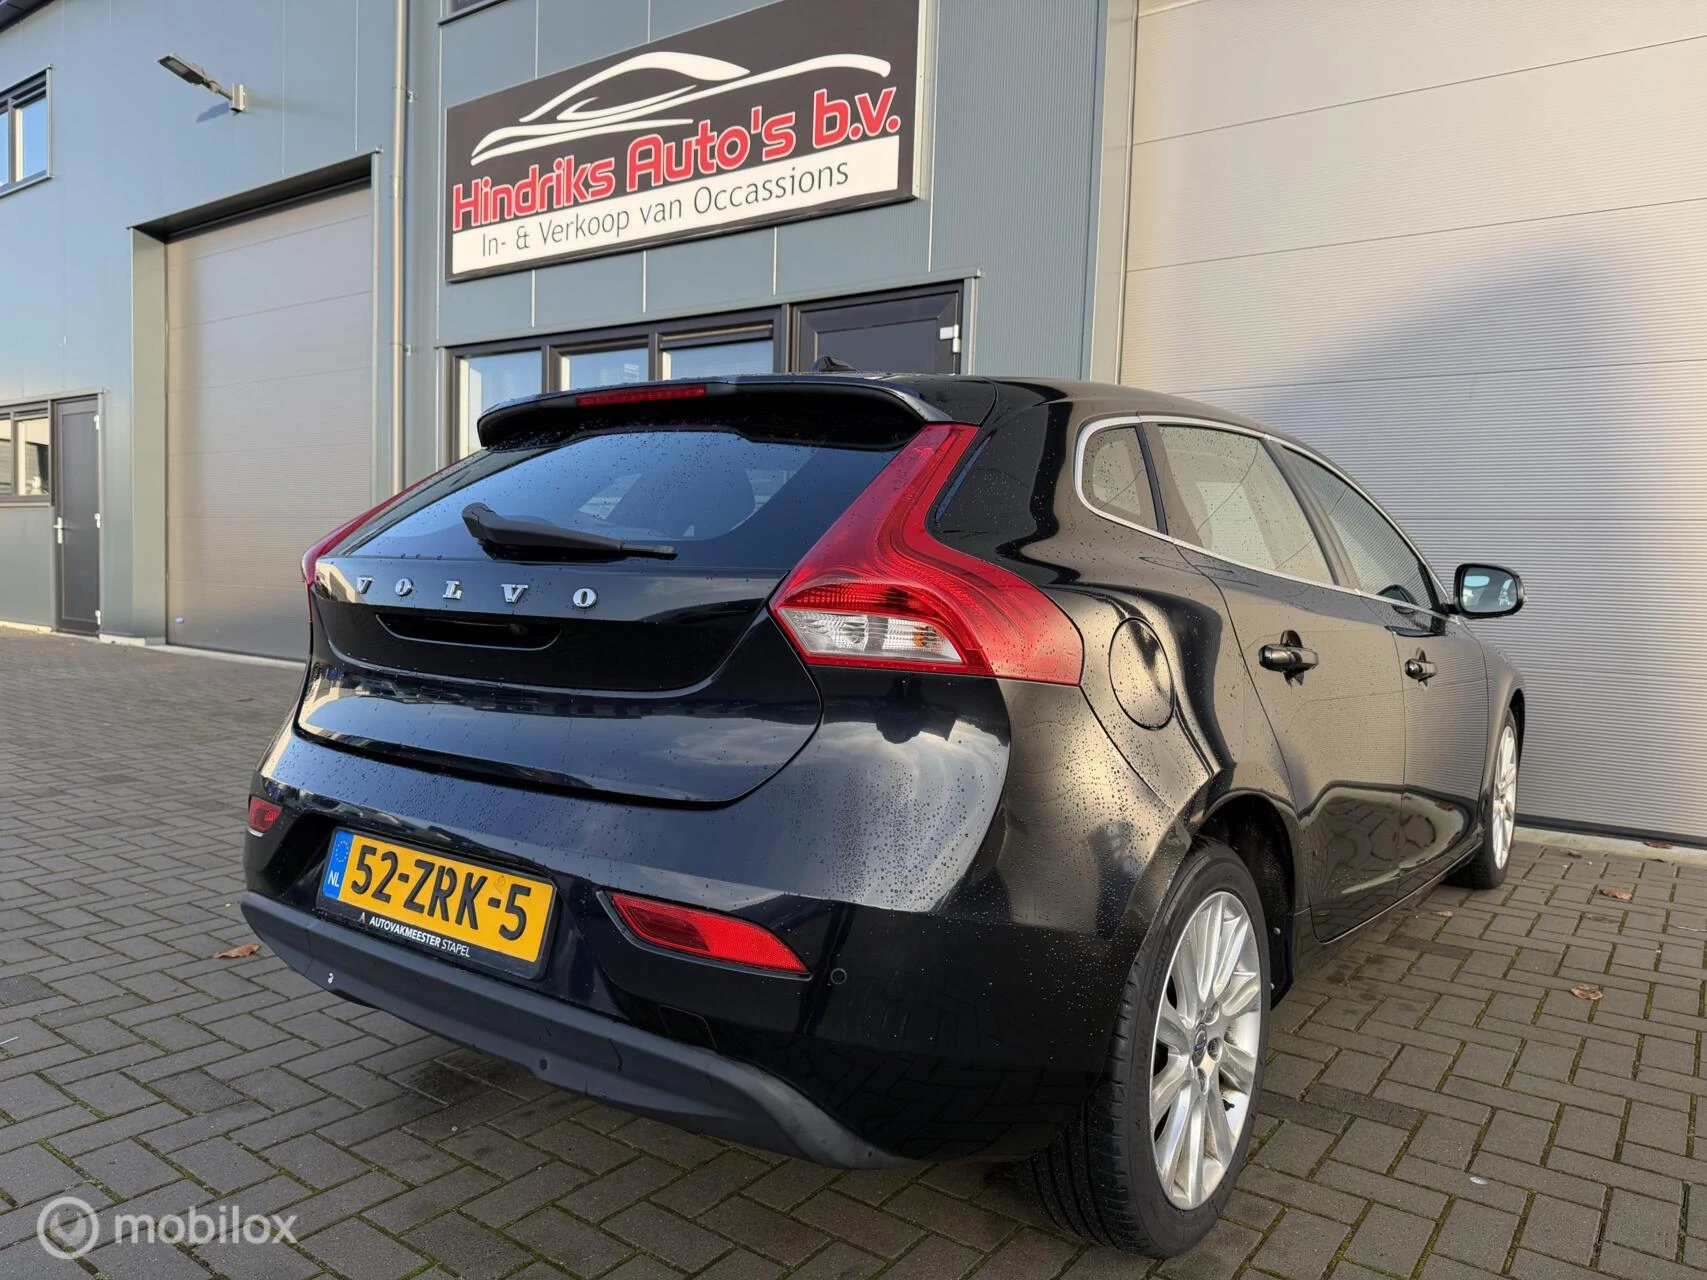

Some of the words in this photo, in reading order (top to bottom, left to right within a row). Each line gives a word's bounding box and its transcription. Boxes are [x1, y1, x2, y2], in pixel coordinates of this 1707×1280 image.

[452, 155, 615, 231] Hindriks
[626, 106, 796, 192] Auto's
[812, 87, 901, 150] b.v.
[482, 233, 506, 257] In-
[515, 225, 530, 250] &
[539, 210, 630, 245] Verkoop
[639, 198, 682, 225] van
[693, 161, 849, 214] Occassions
[356, 576, 598, 608] VOLVO
[327, 870, 340, 888] NL
[350, 844, 532, 940] 52-ZRK-5
[369, 915, 441, 947] AUTOVAKMEESTER
[441, 938, 471, 958] STAPEL
